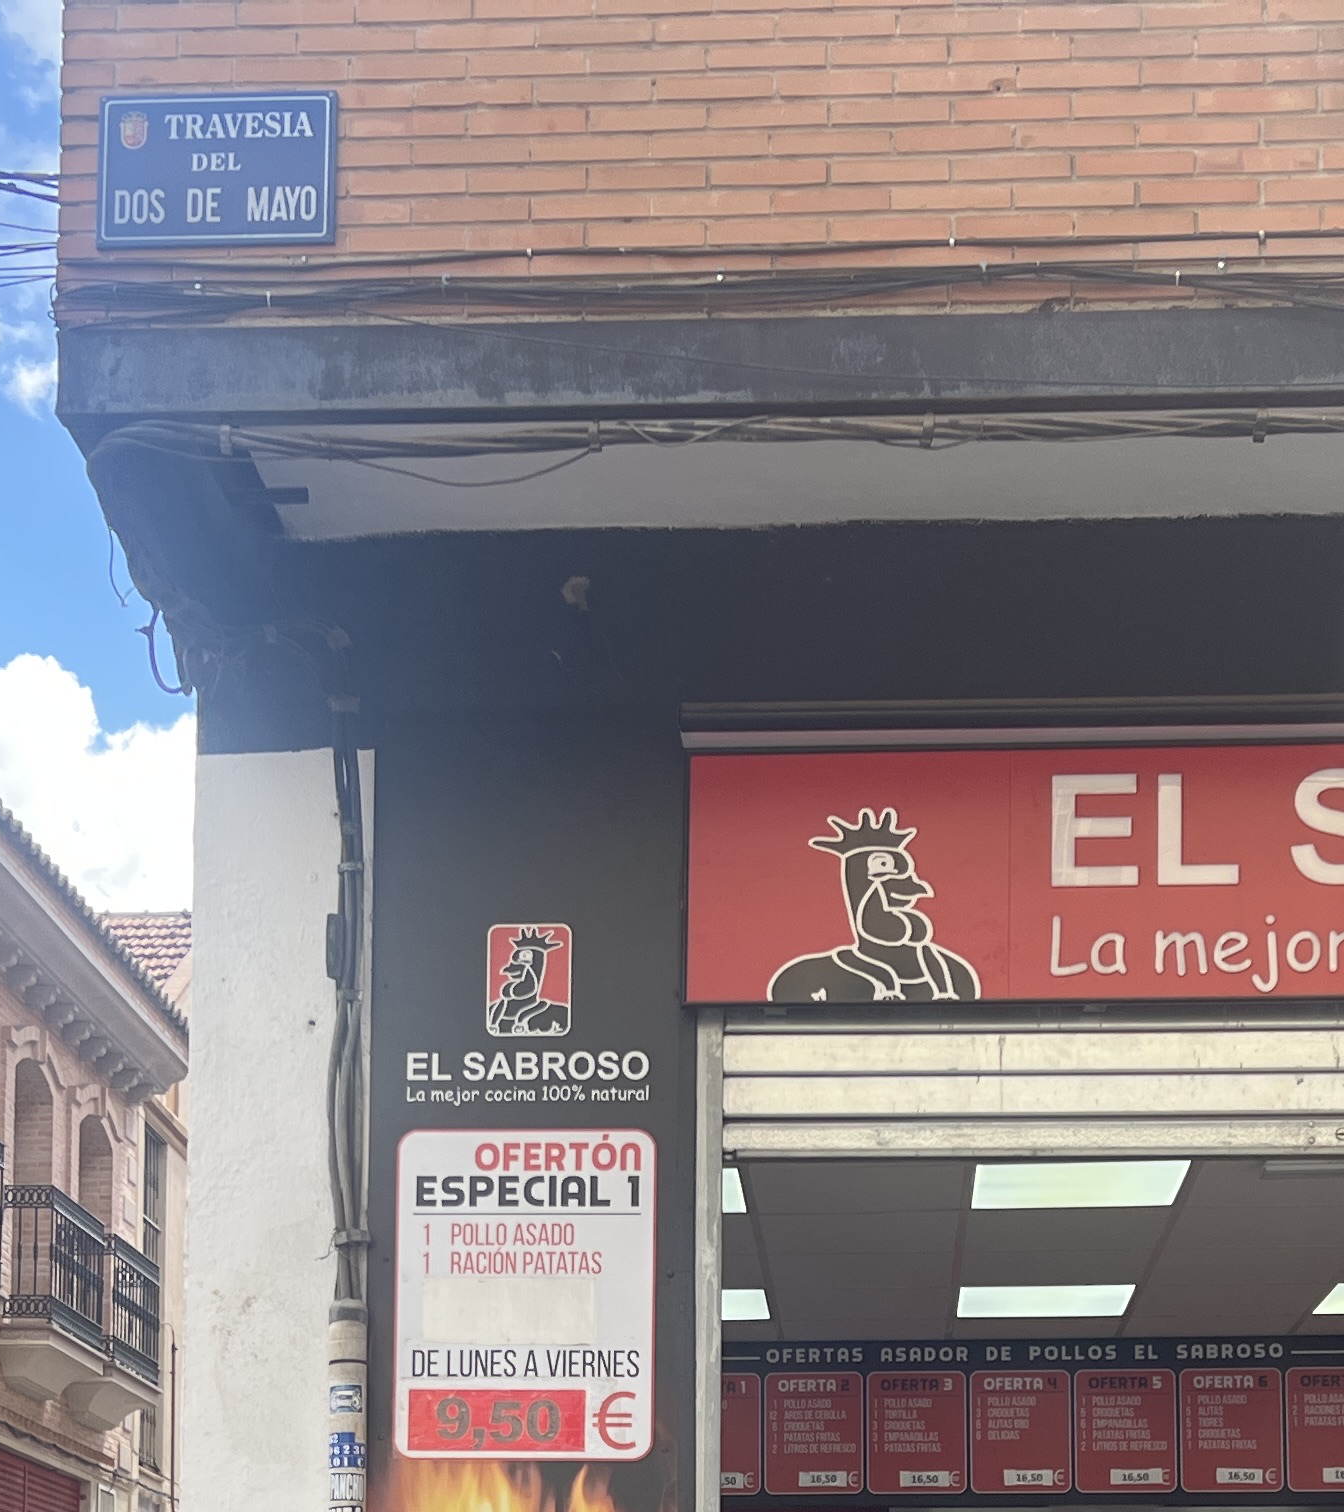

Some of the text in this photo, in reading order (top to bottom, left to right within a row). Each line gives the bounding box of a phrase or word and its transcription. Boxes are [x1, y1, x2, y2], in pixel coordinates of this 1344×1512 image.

[164, 111, 314, 140] TRAVESIA
[191, 152, 242, 172] DEL
[114, 185, 317, 224] DOS DE MAYO
[1050, 771, 1241, 889] EL
[1050, 914, 1127, 978] La
[406, 1050, 650, 1082] EL SABROSO
[406, 1085, 650, 1107] La mejor cocina 100% natural
[474, 1134, 642, 1172] OFERTÓN
[415, 1175, 641, 1208] ESPECIAL 1
[422, 1223, 575, 1247] 1 POLLO ASADO
[422, 1247, 602, 1275] 1 RACIÓN PATATAS
[412, 1349, 641, 1378] DE LUNES A VIERNES
[765, 1343, 1284, 1364] OFERTAS ASADOR DE POLLOS EL SABROSO
[778, 1379, 850, 1393] OFERTA 2
[880, 1378, 953, 1392] OFERTA 3
[983, 1378, 1057, 1391] OFERTA 4
[1088, 1377, 1162, 1391] OFERTA 5
[1193, 1375, 1268, 1389] OFERTA 6
[435, 1391, 636, 1452] 9,50 €
